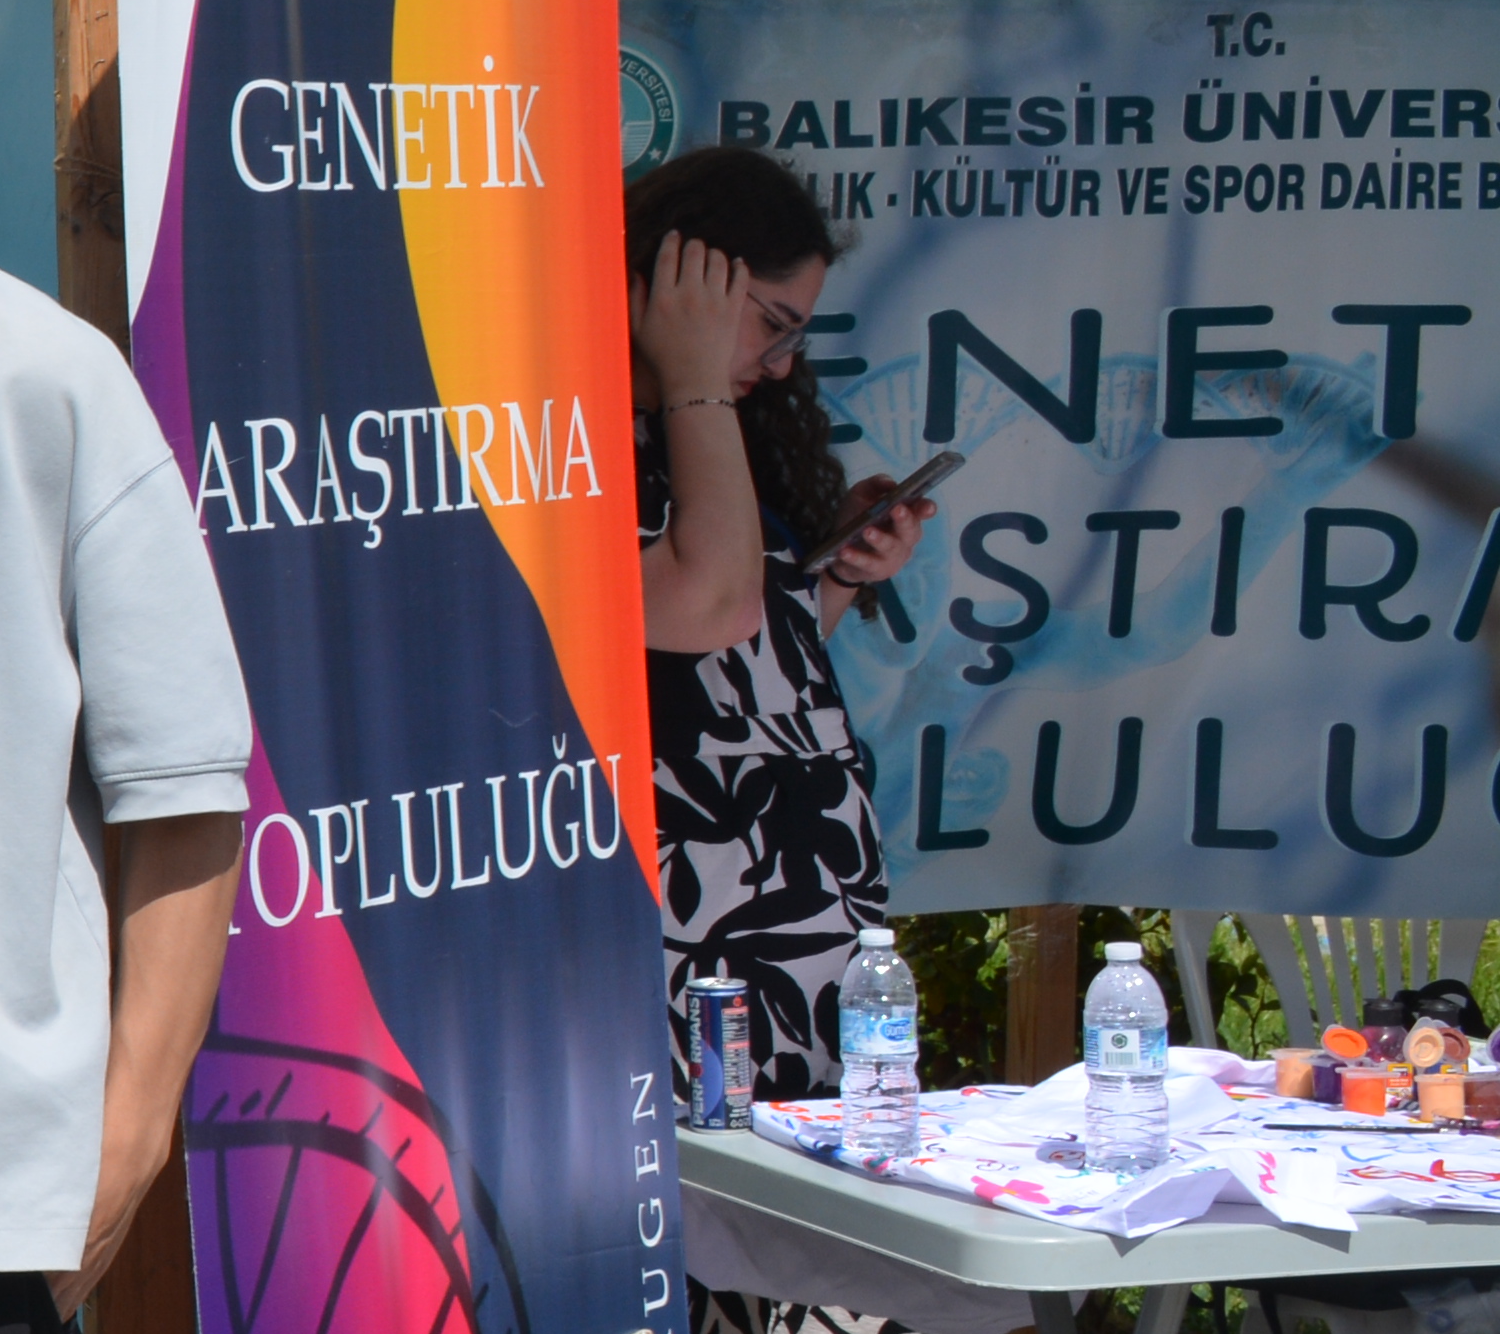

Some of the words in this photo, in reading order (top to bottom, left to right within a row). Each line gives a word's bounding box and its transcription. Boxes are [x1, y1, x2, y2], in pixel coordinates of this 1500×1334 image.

[1207, 10, 1286, 58] T.C.
[231, 54, 545, 192] GENETİK
[718, 80, 1154, 150] BALIKESİR
[1182, 76, 1500, 142] ÜNİVER
[780, 158, 875, 219] LIK
[912, 154, 1100, 219] KÜLTÜR
[1118, 166, 1170, 217] VE
[1182, 162, 1304, 214] SPOR
[1320, 147, 1463, 210] DAİRE
[195, 394, 602, 549] ARAŞTIRMA
[226, 732, 623, 936] OPLULUĞU
[862, 715, 1500, 859] LULU
